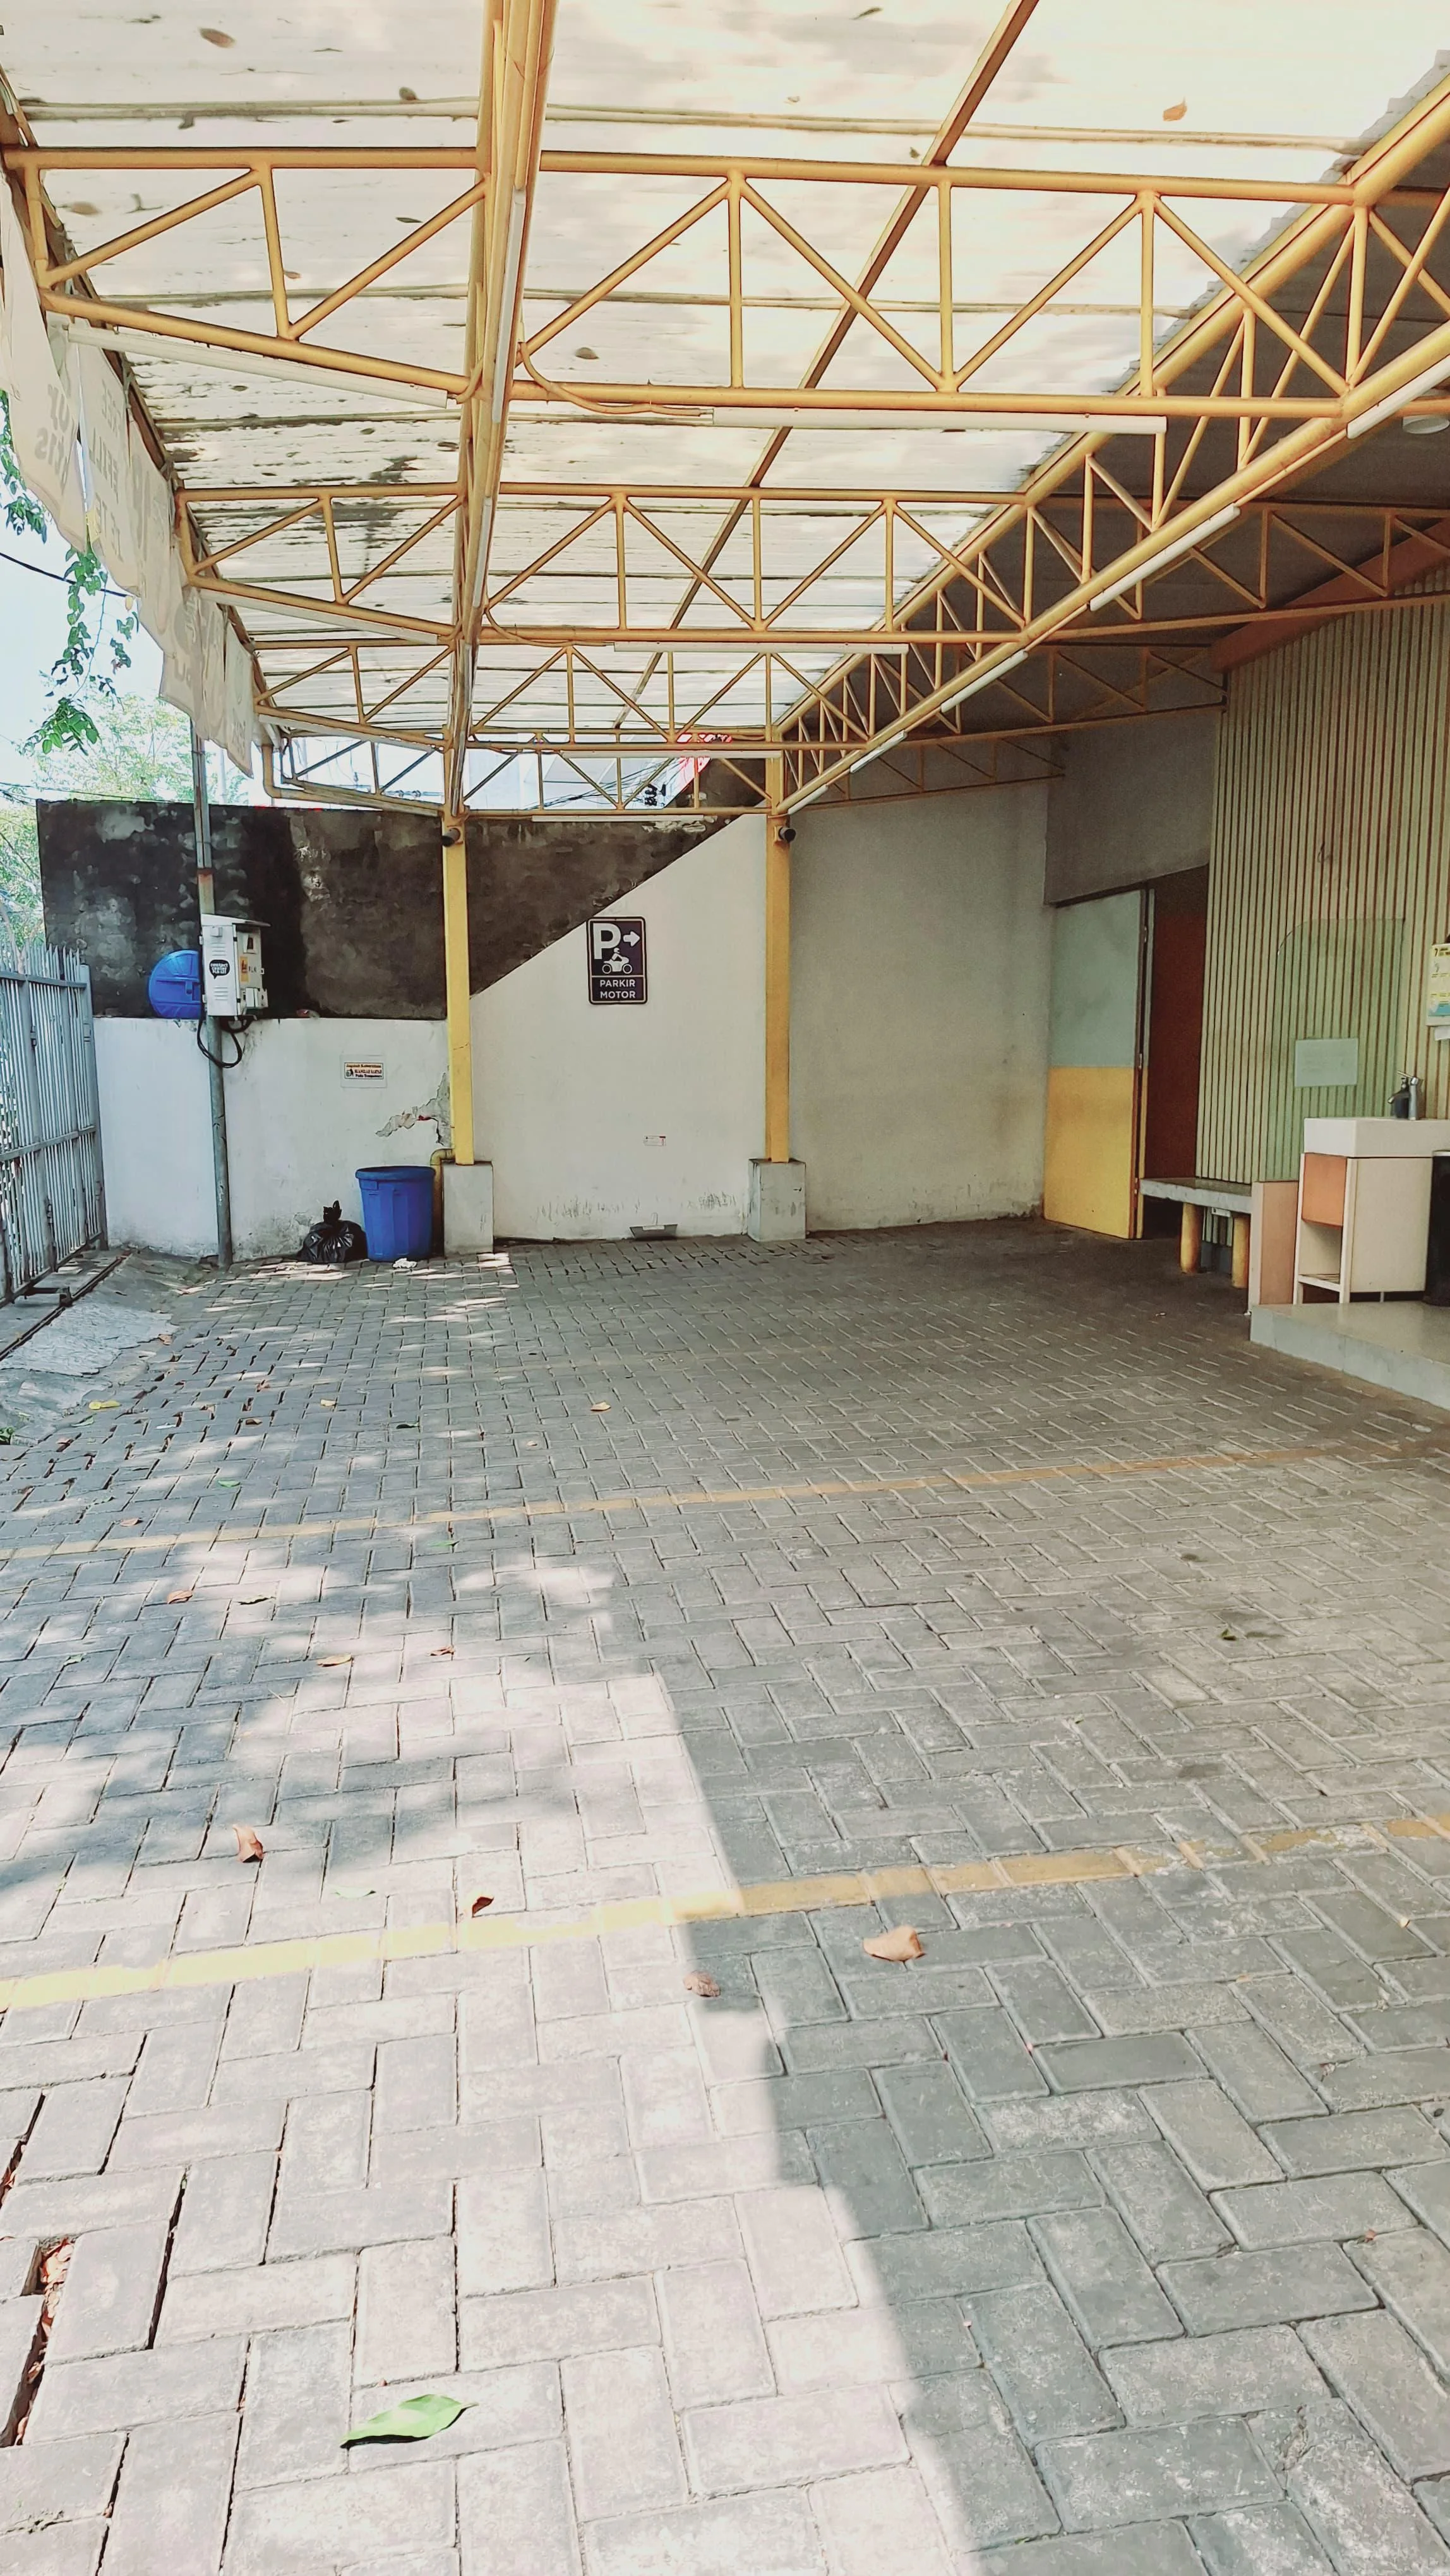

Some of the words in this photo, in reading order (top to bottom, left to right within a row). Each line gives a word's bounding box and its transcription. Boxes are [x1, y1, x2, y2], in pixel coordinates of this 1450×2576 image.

[592, 922, 621, 960] P
[599, 979, 635, 987] PARKIR
[601, 991, 636, 999] MOTOR
